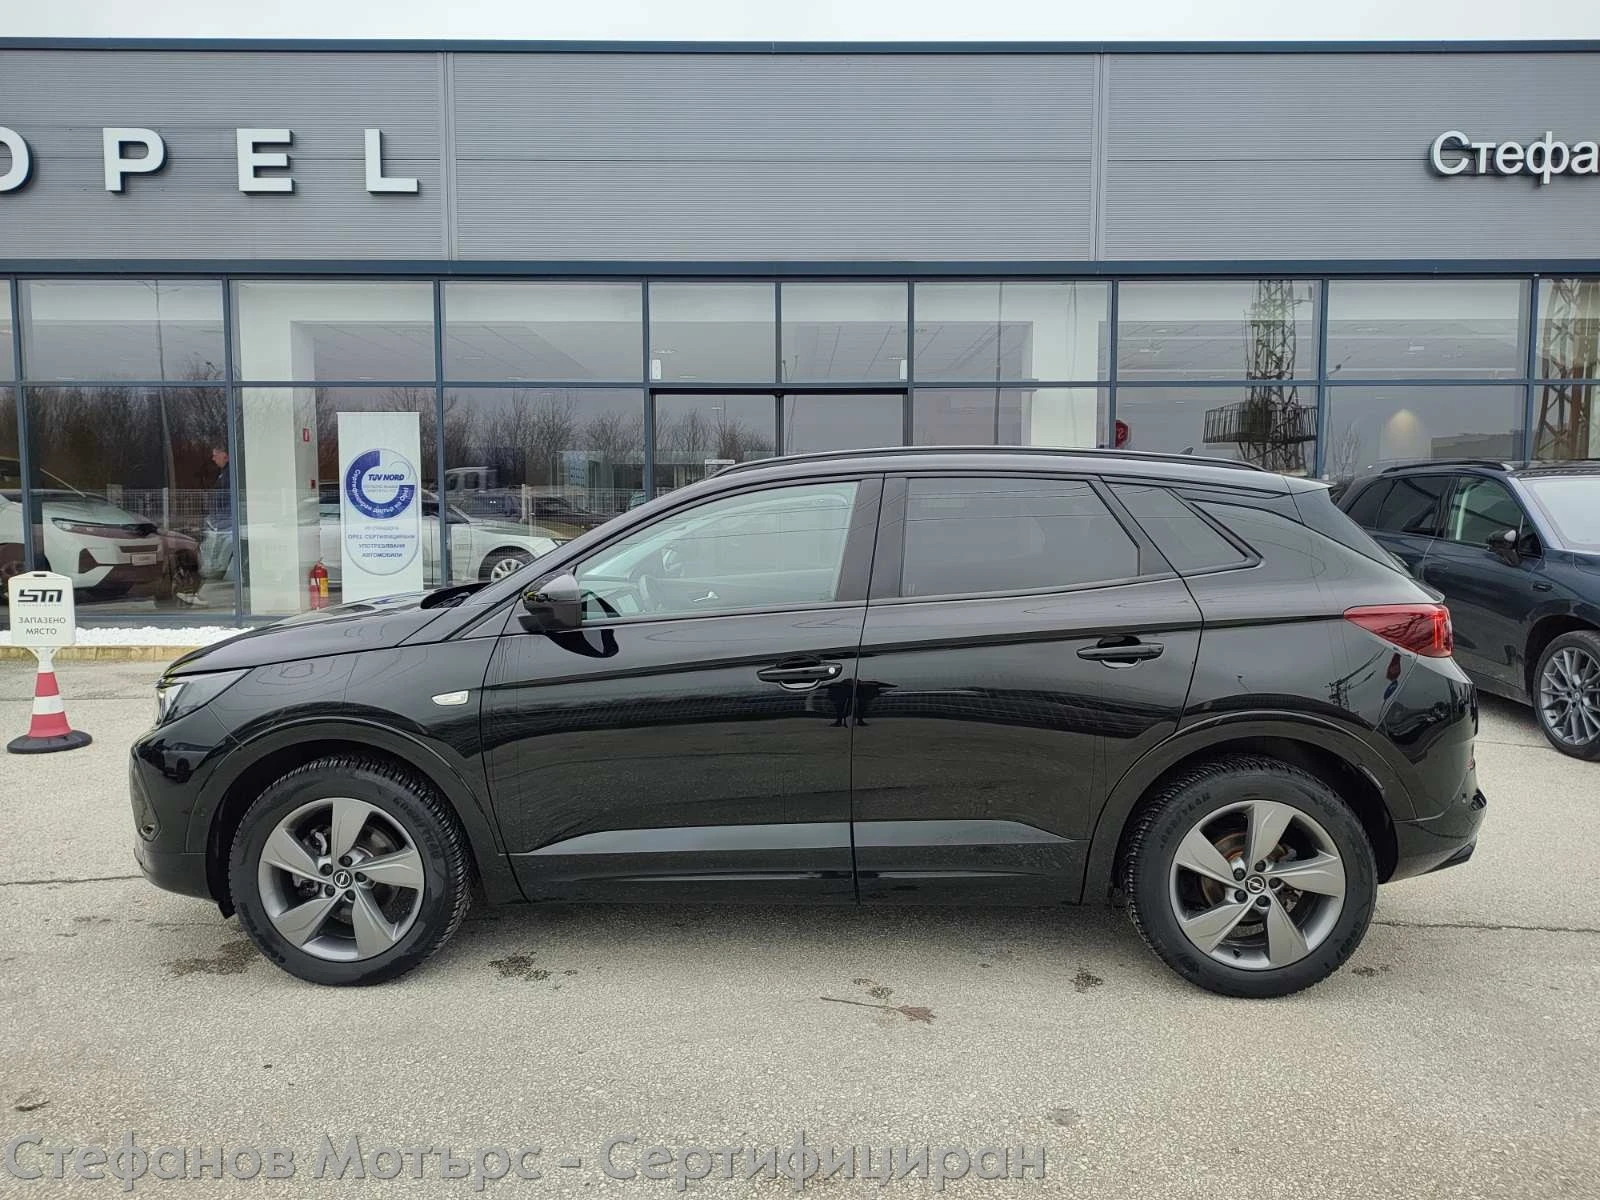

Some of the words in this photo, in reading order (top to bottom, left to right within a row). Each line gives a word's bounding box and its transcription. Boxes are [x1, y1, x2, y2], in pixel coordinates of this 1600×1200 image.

[1432, 130, 1599, 185] Стефа
[383, 473, 405, 481] NORD
[17, 616, 66, 624] ЗАПАЗЕНО
[25, 627, 57, 635] МЯСТО
